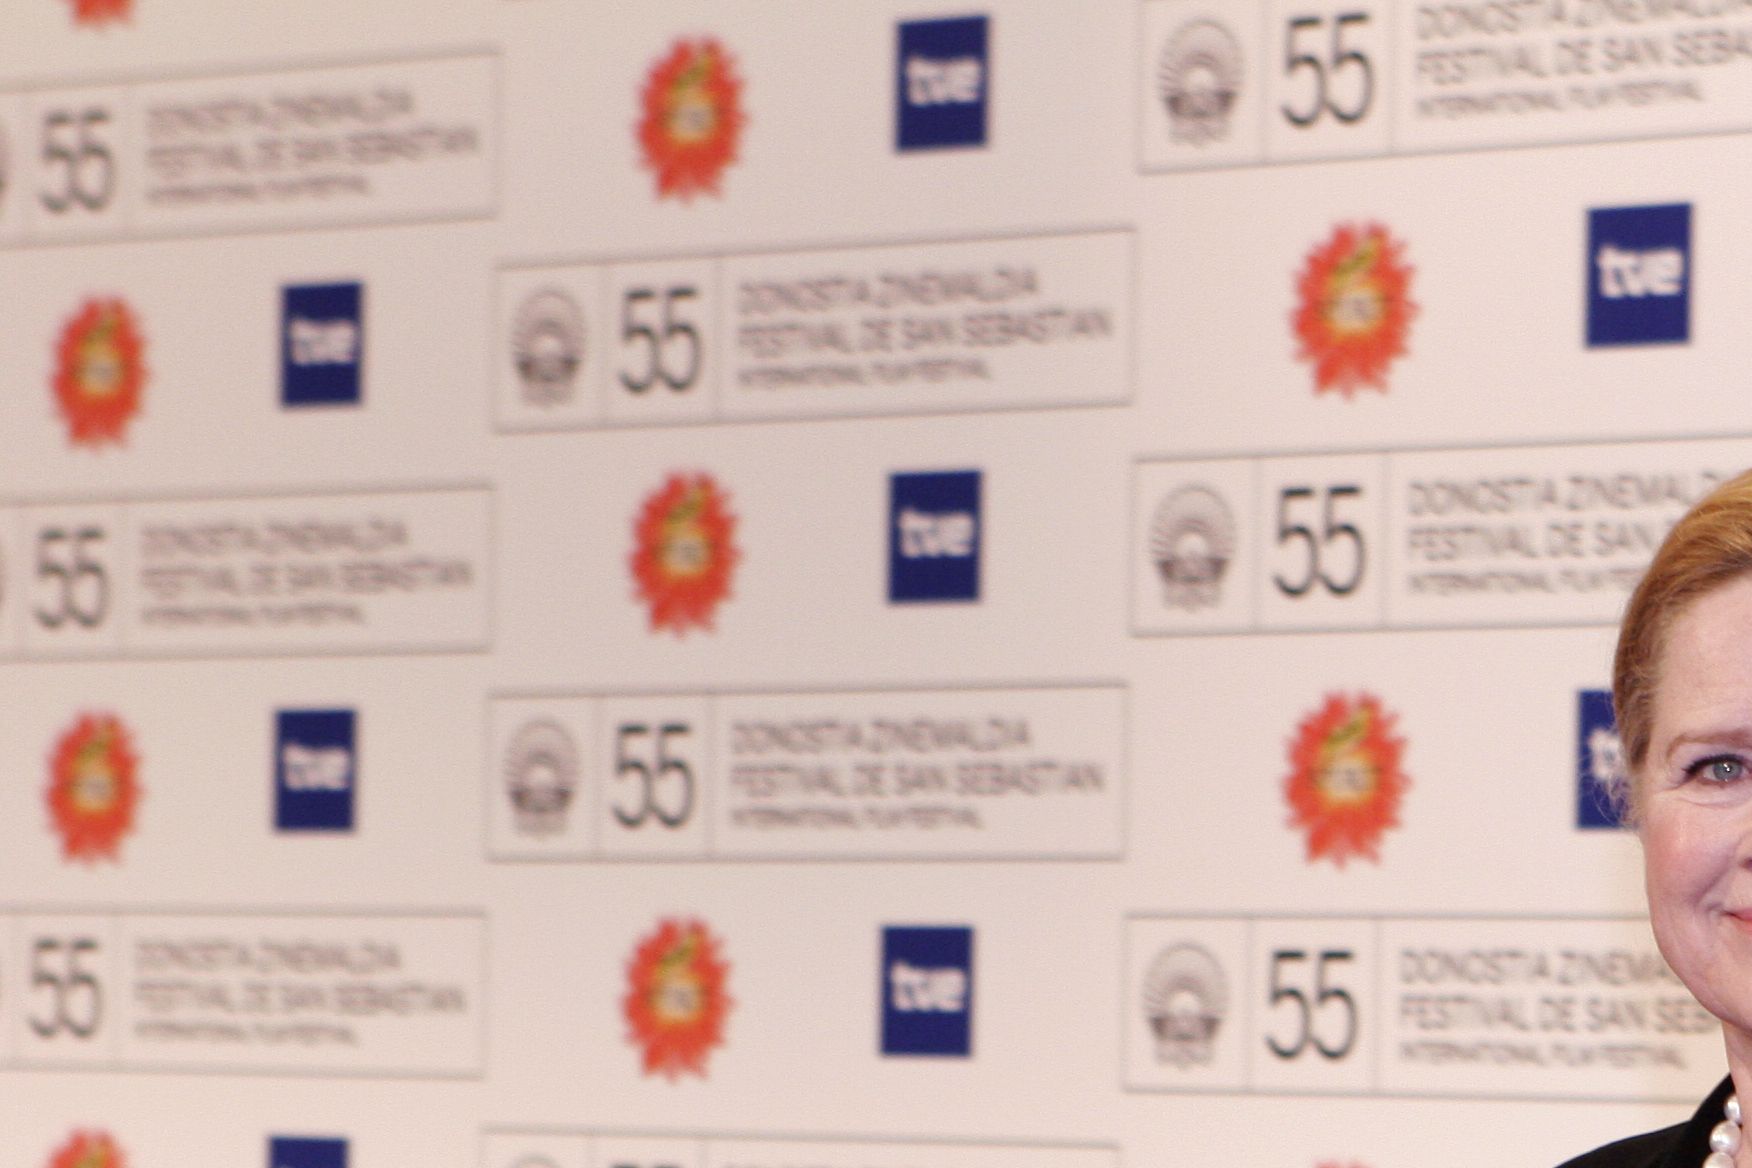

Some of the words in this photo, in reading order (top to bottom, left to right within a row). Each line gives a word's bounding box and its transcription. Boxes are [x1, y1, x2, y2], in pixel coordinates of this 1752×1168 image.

[905, 58, 982, 105] tve
[1280, 12, 1375, 128] 55
[1417, 42, 1549, 86] FESTIVAL
[1554, 38, 1593, 76] DE
[1601, 33, 1665, 72] SAN
[39, 110, 114, 212] 55
[1598, 247, 1683, 298] tve
[618, 287, 702, 394] 55
[1409, 476, 1560, 516] DONOSTIA
[899, 511, 974, 557] tve
[1272, 485, 1367, 597] 55
[1409, 523, 1540, 562] FESTIVAL
[1545, 522, 1585, 557] DE
[1592, 519, 1656, 556] SAN
[34, 529, 109, 628] 55
[611, 724, 695, 827] 55
[28, 940, 103, 1037] 55
[891, 963, 966, 1012] tve
[1401, 949, 1552, 985] DONOSTIA
[1264, 950, 1359, 1060] 55
[1401, 995, 1532, 1031] FESTIVAL
[1537, 996, 1577, 1031] DE
[1584, 997, 1648, 1032] SAN
